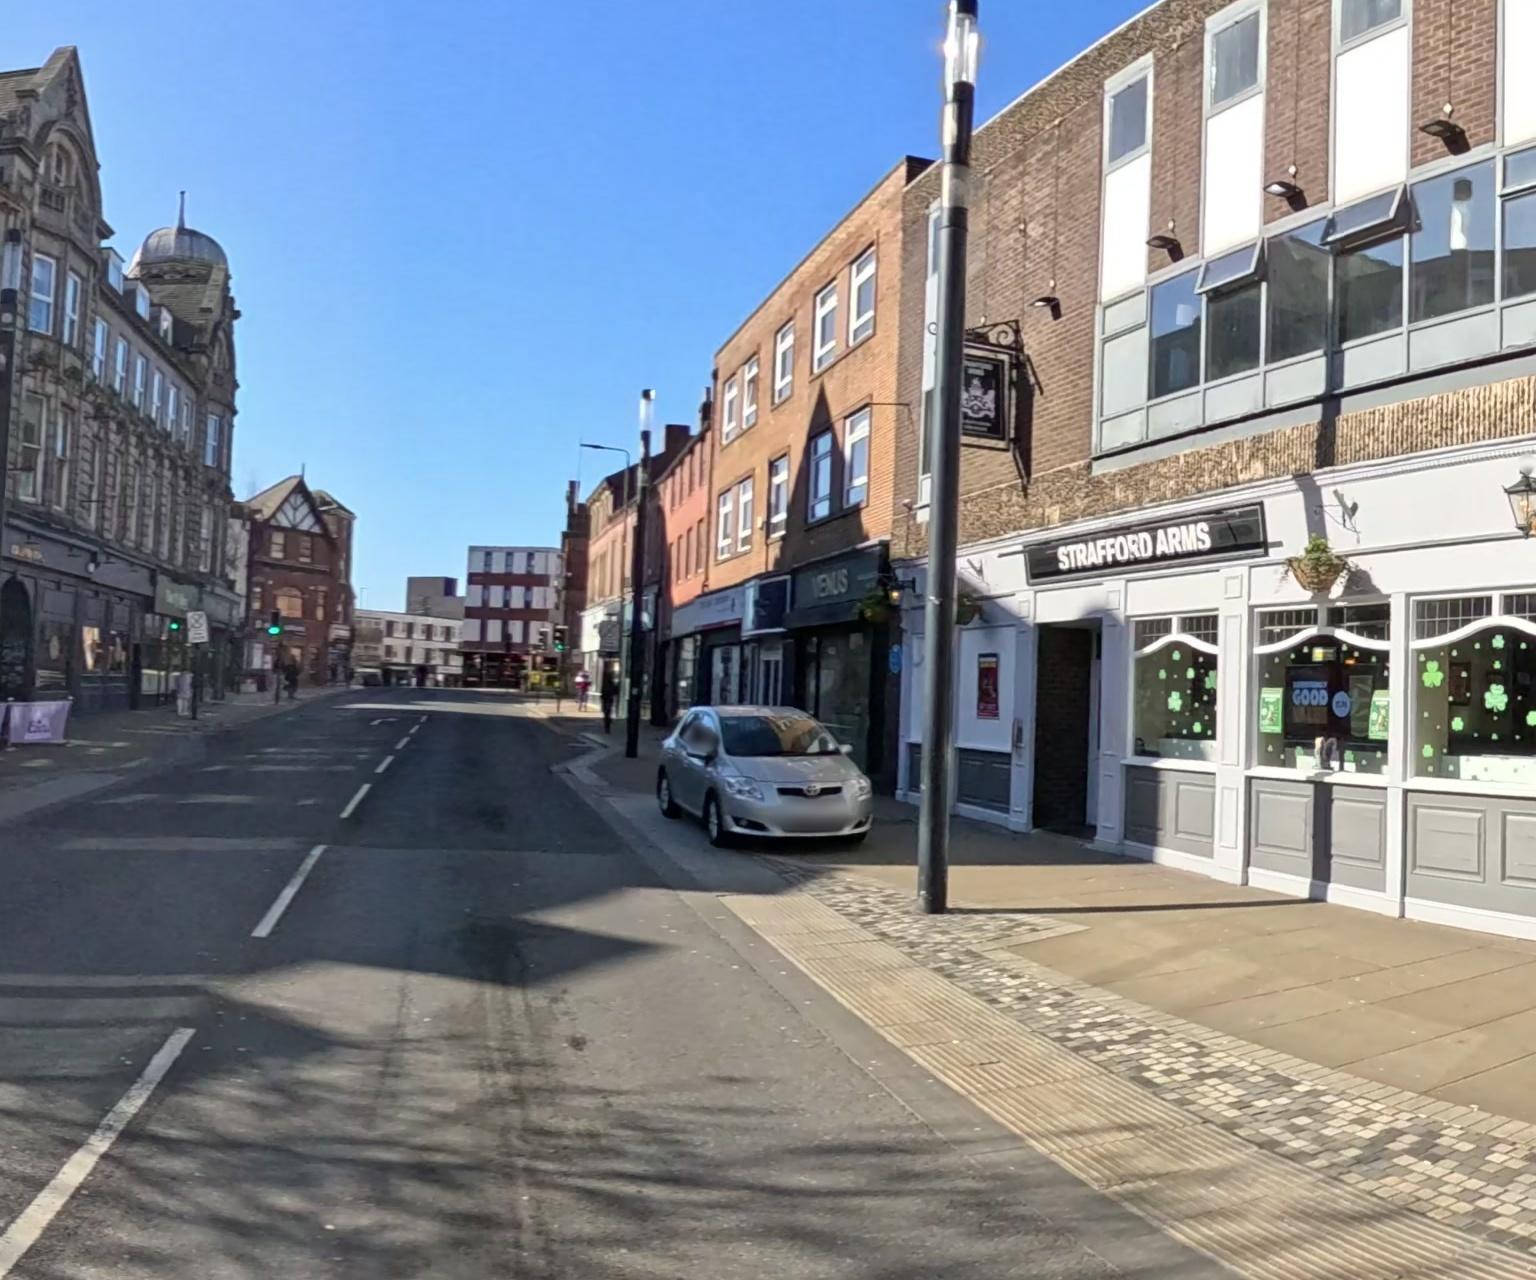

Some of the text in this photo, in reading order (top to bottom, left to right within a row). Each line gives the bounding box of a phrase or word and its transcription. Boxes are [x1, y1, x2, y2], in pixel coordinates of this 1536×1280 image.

[1056, 522, 1212, 570] STRAFFORD ARMS
[1292, 688, 1329, 706] GOOD
